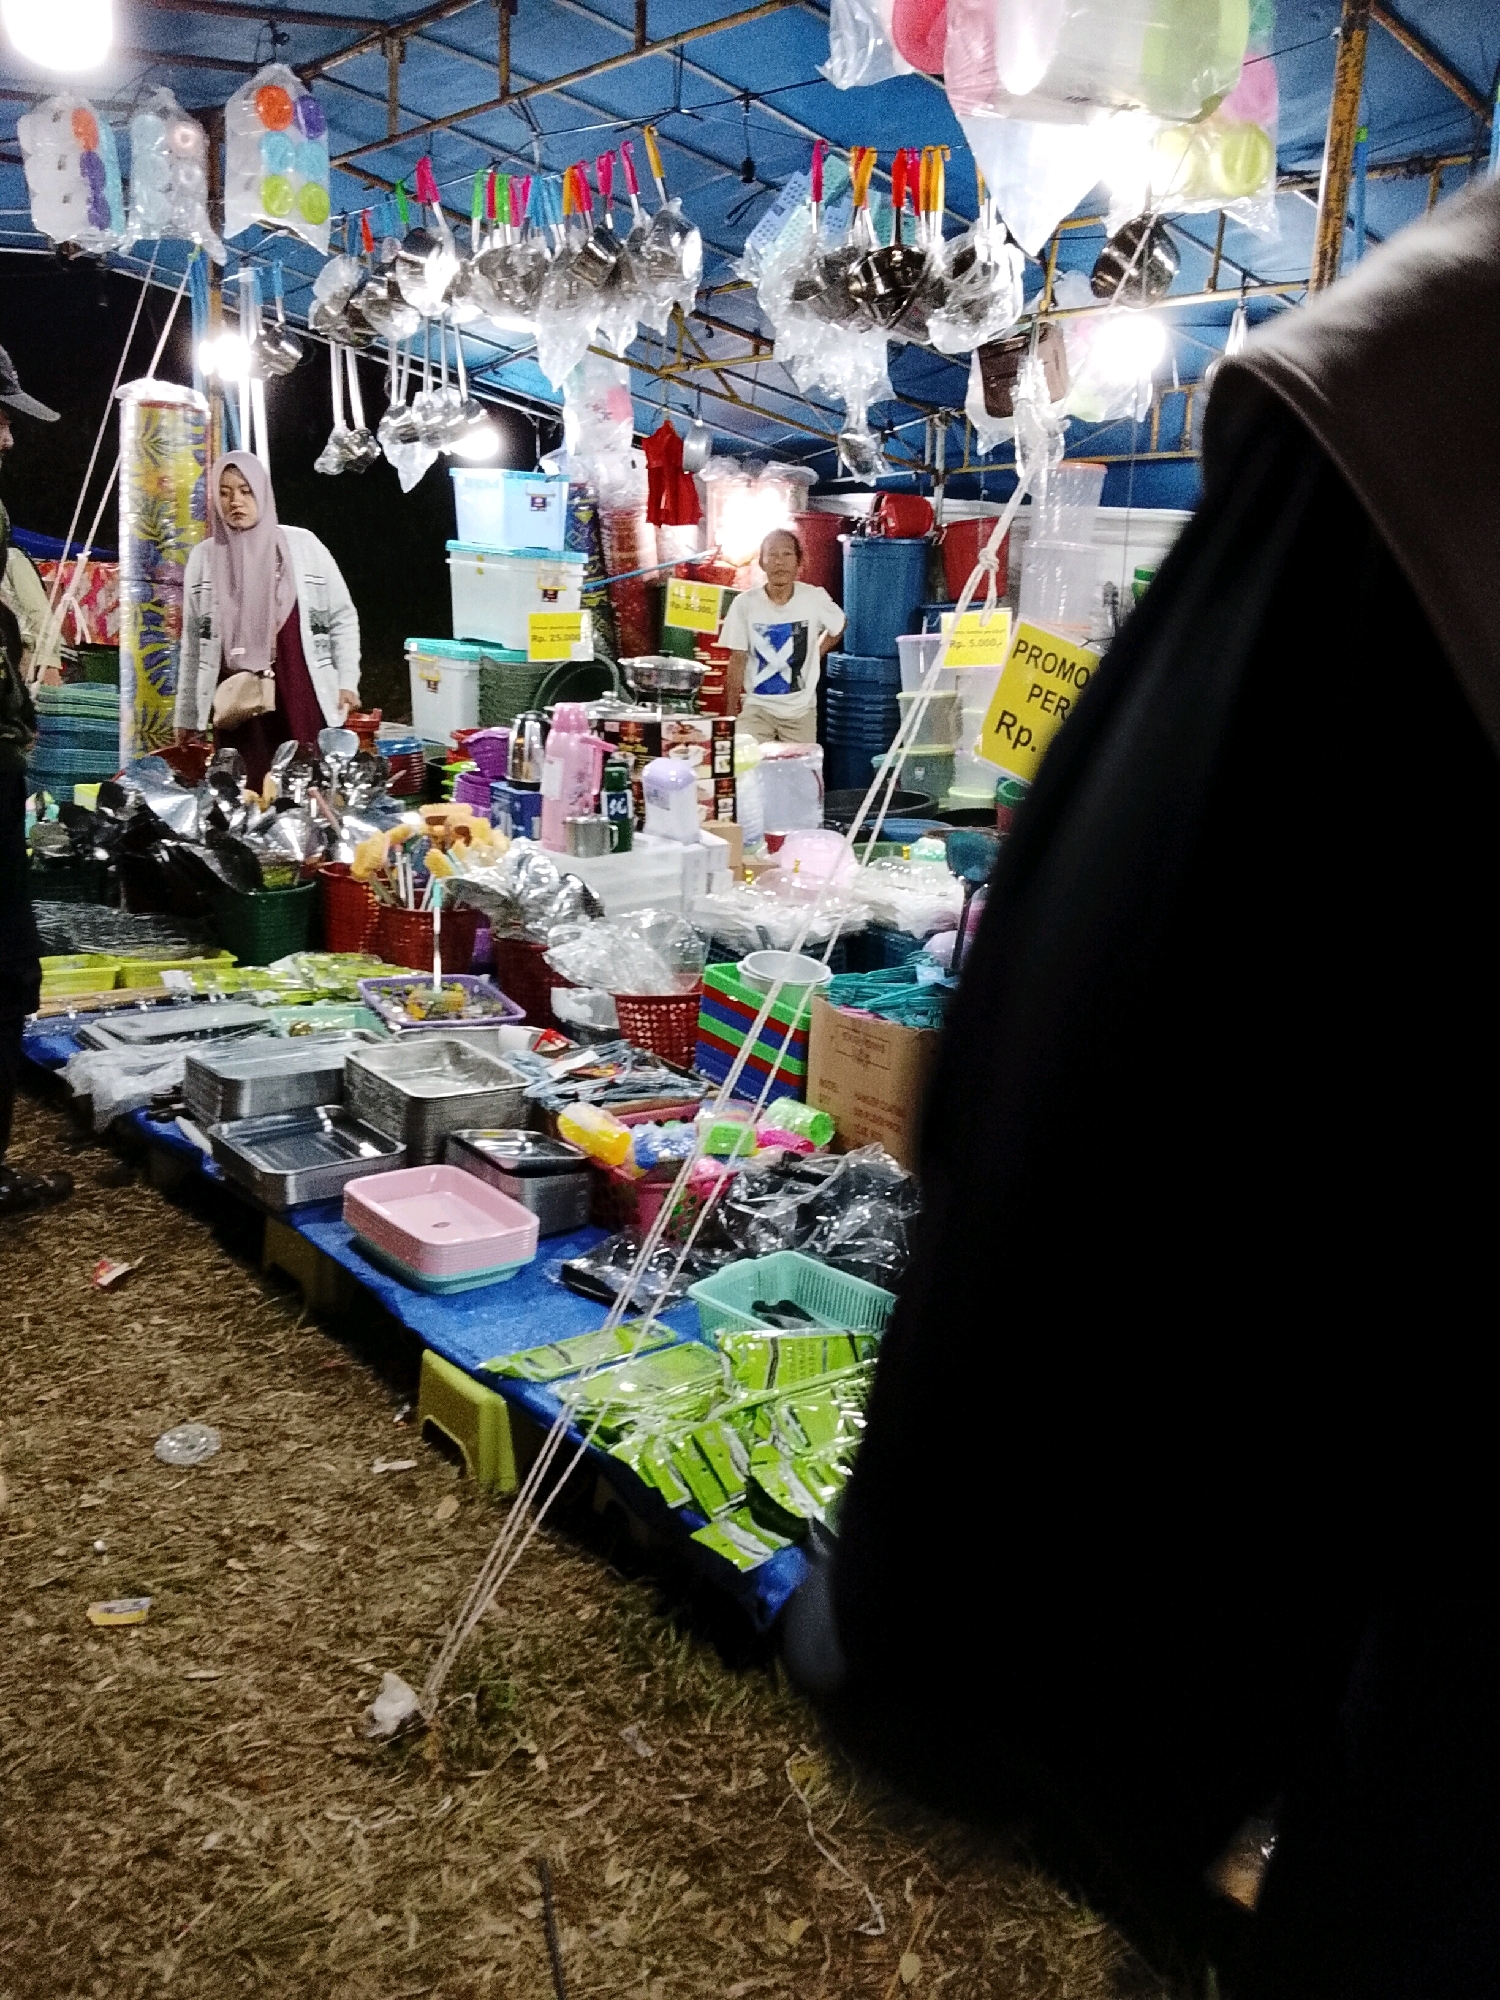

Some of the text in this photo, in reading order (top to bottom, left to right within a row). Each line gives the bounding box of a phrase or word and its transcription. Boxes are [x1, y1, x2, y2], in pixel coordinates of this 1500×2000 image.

[1012, 638, 1090, 690] PROMO
[1026, 683, 1071, 721] PER
[994, 709, 1036, 752] Rp.
